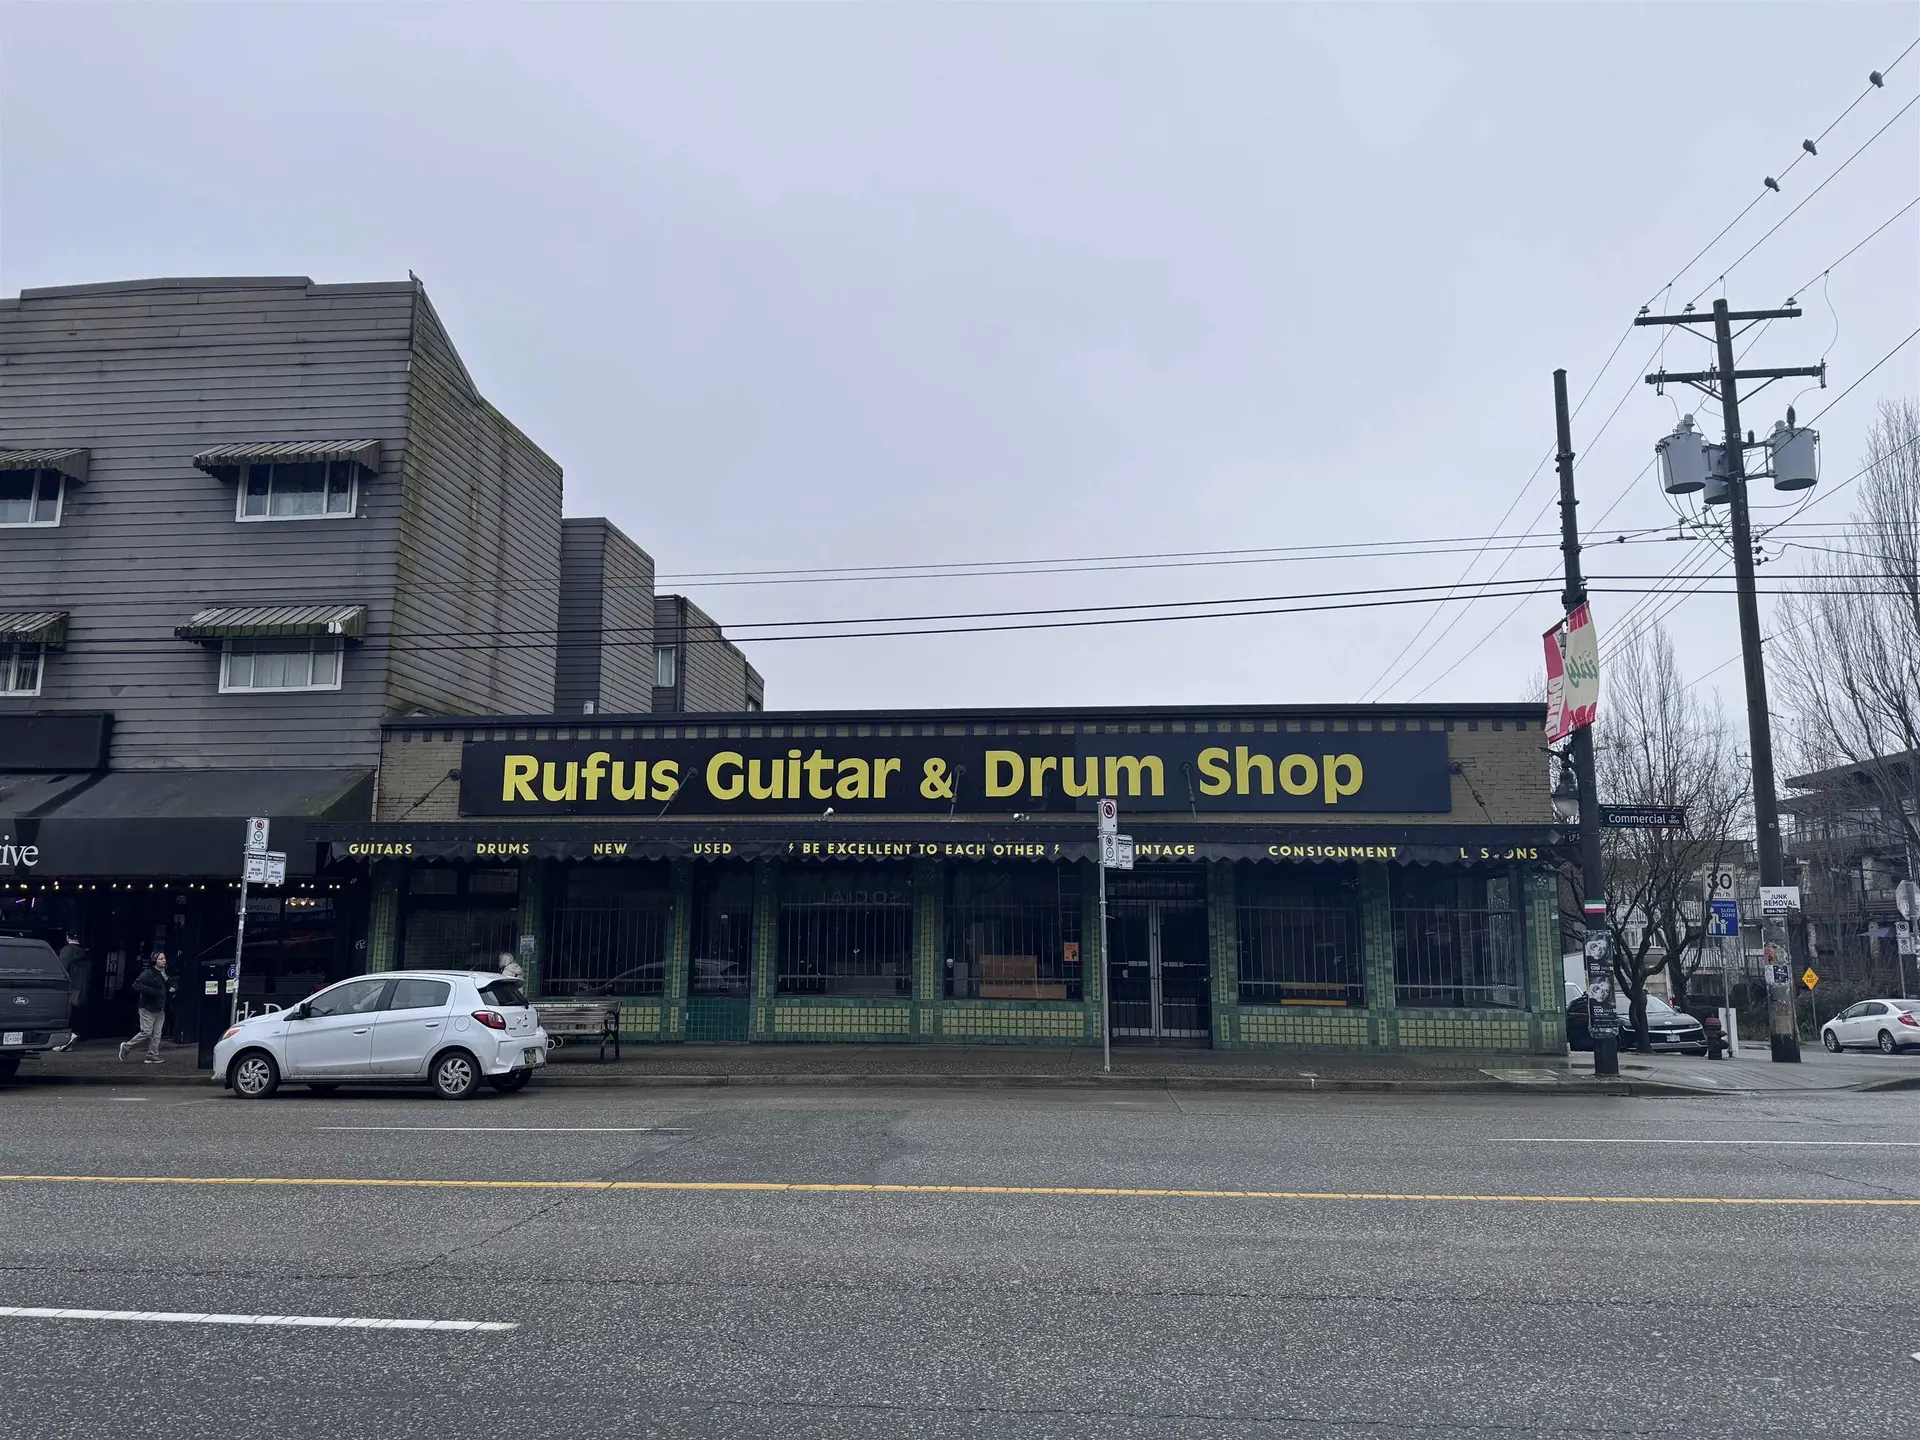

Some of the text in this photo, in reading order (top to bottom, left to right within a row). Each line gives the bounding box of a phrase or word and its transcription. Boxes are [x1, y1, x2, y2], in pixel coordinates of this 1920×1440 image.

[503, 746, 1364, 803] Rufus Guitar & Drum Shop
[1608, 813, 1667, 824] Commercial
[348, 843, 413, 855] GUITARS
[476, 843, 530, 855] DRUMS
[593, 843, 627, 855] NEW
[693, 843, 732, 854] USED
[803, 843, 1045, 856] BE EXCELLENT TO EACH OTHER
[1135, 844, 1195, 856] INTAGE
[1268, 846, 1397, 857] CONSIGNMENT
[1707, 873, 1732, 890] 30
[1763, 899, 1797, 907] REMOVAL
